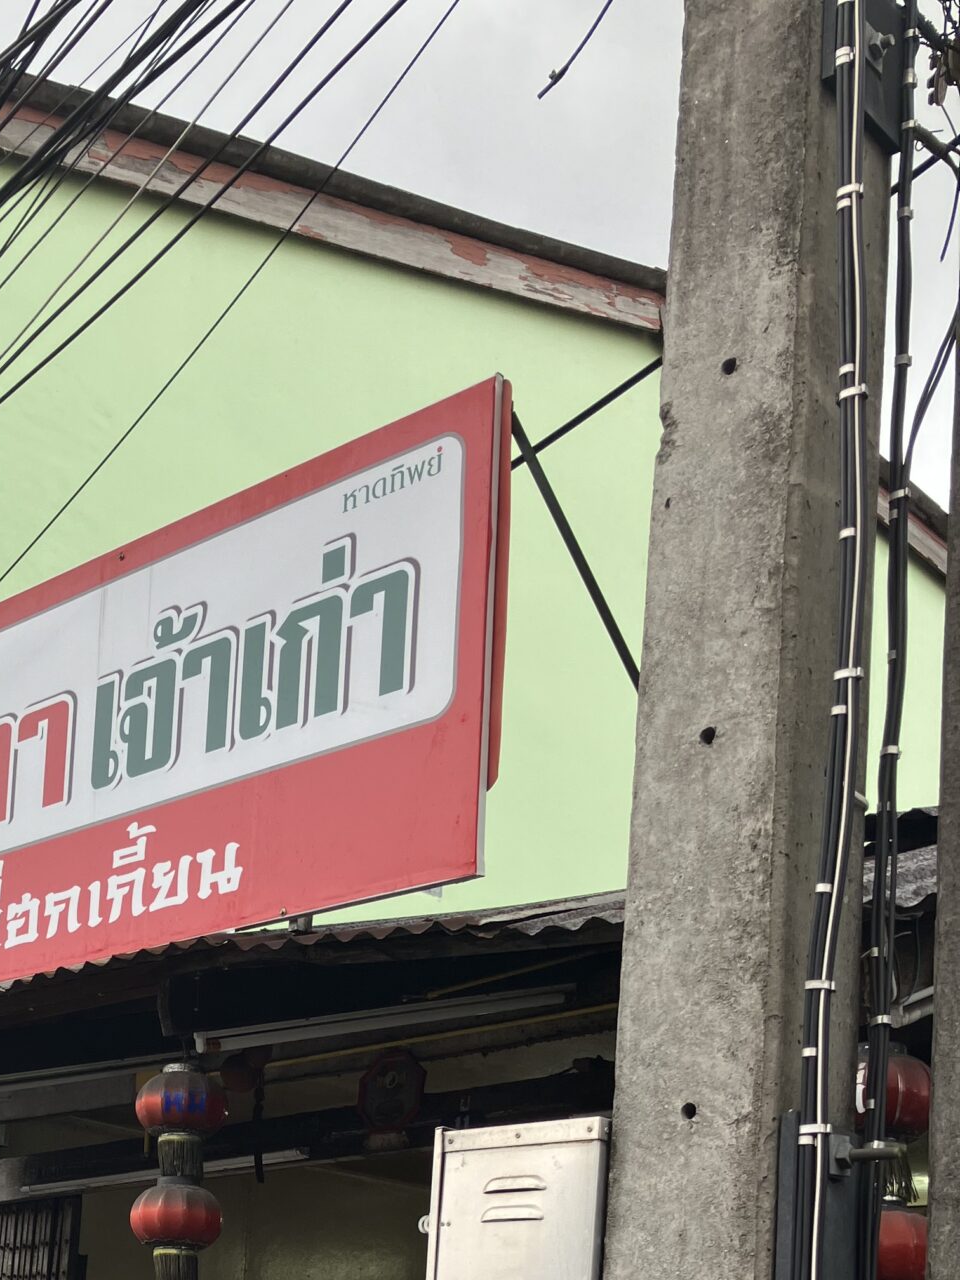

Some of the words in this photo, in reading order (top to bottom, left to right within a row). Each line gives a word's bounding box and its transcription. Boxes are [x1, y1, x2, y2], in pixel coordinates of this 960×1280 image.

[341, 446, 444, 514] หาดทิพย์
[90, 540, 415, 790] เจ้าเก่า
